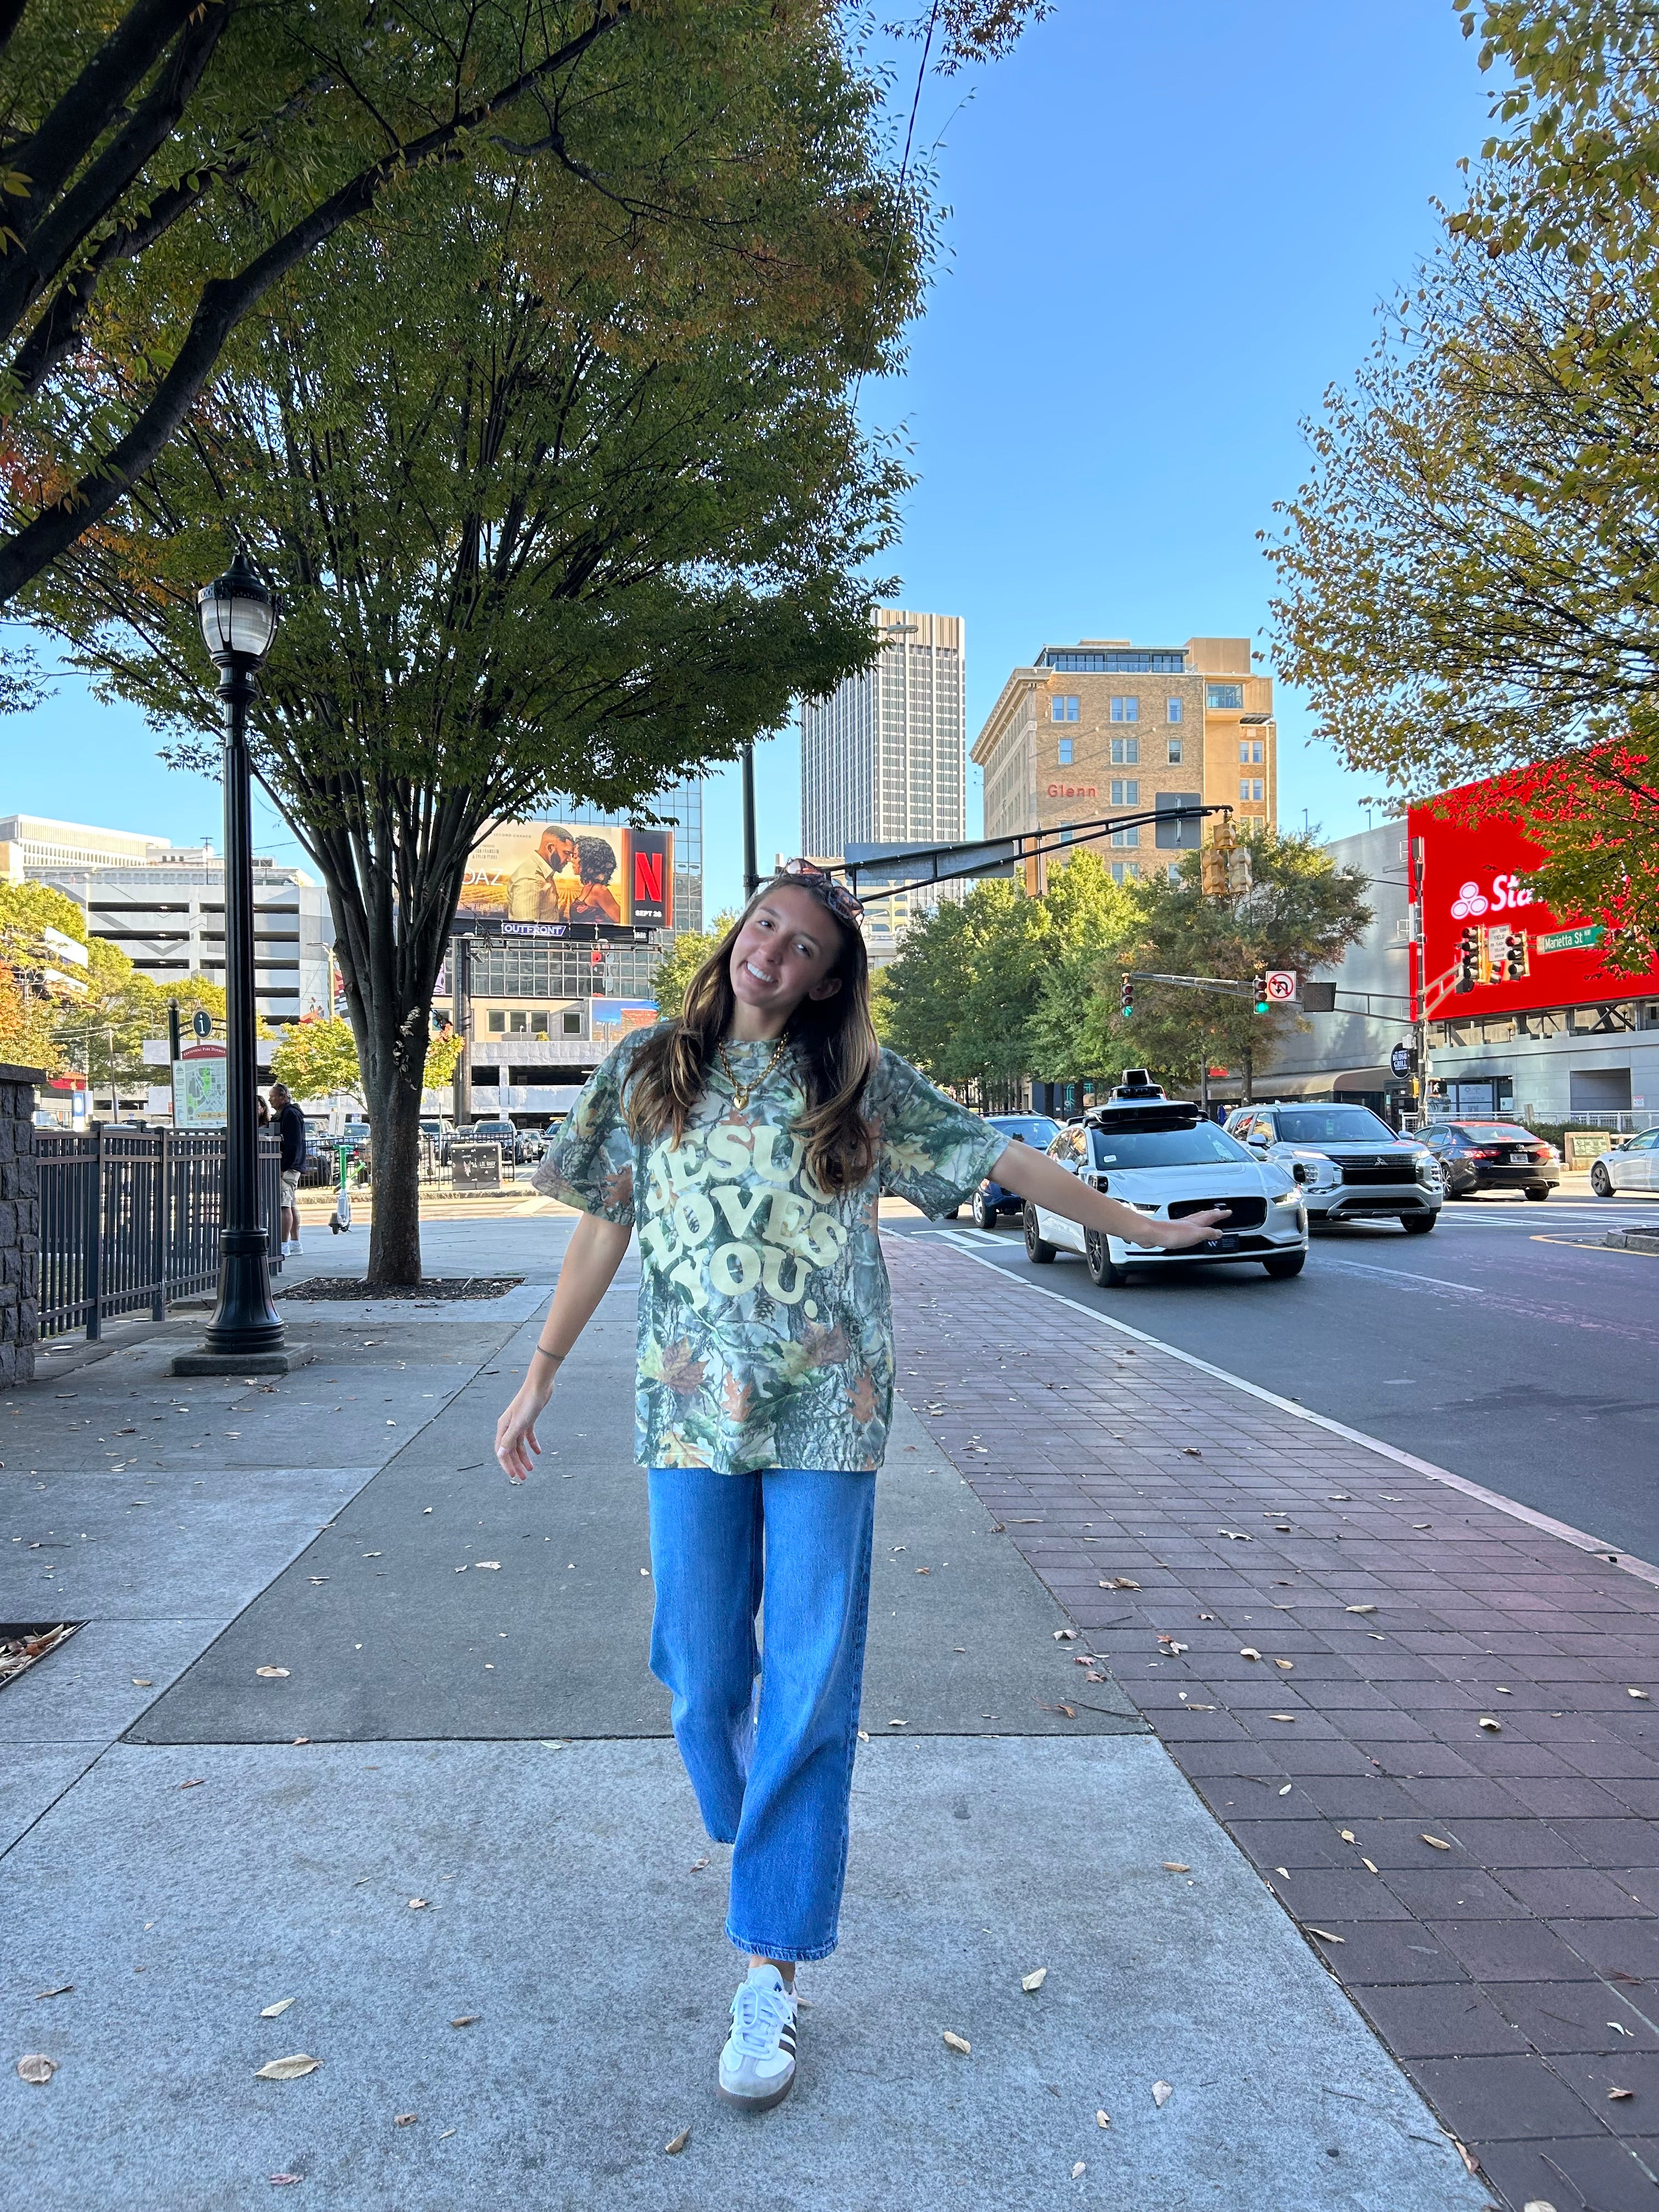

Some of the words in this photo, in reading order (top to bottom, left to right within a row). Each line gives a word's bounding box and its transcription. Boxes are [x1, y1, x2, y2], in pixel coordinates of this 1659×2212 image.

[1048, 784, 1096, 797] Glenn
[462, 867, 504, 885] OAZ
[635, 852, 662, 902] N
[1490, 874, 1543, 911] Sta
[504, 924, 562, 934] OUTFRONT
[1545, 934, 1572, 950] Marietta
[1574, 932, 1583, 944] St
[1392, 1053, 1407, 1062] HUDSO
[639, 1185, 847, 1272] LOVES
[669, 1242, 819, 1319] YOU.
